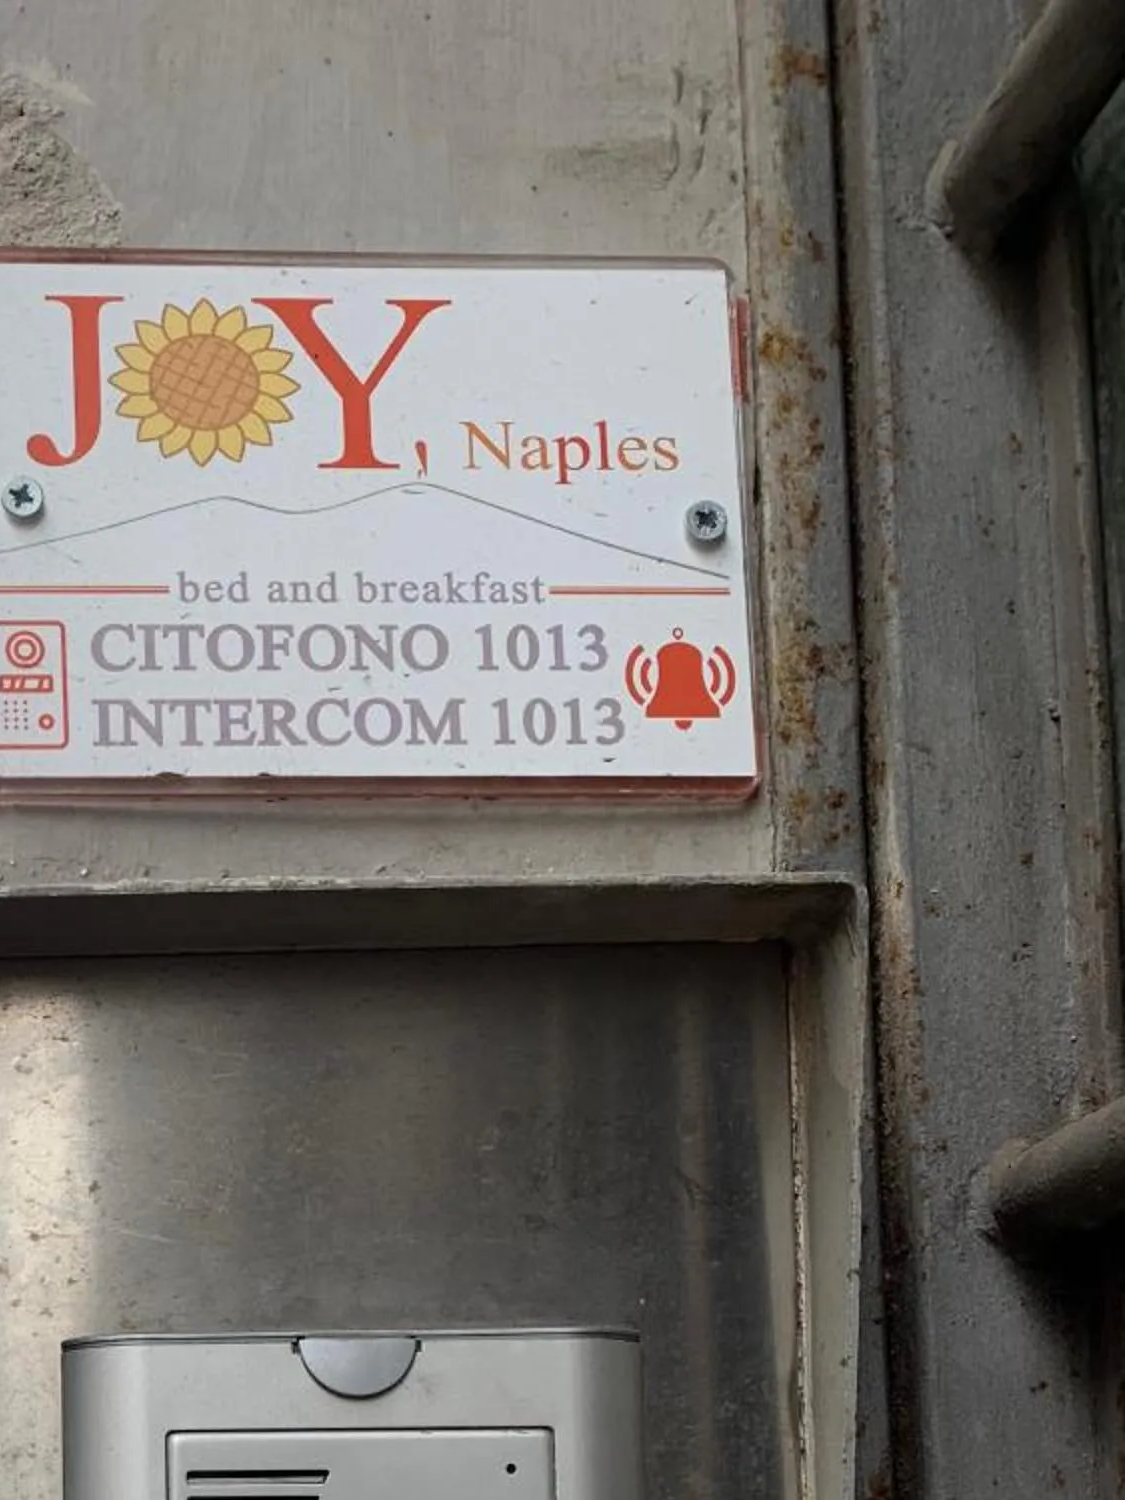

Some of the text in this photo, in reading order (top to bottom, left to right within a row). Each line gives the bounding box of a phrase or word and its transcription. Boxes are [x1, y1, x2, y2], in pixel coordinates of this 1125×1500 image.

[463, 419, 680, 486] Naples
[176, 570, 546, 604] bed and breakfast
[89, 623, 610, 673] CITOFONO 1013
[91, 696, 626, 748] INTERCOM 1013
